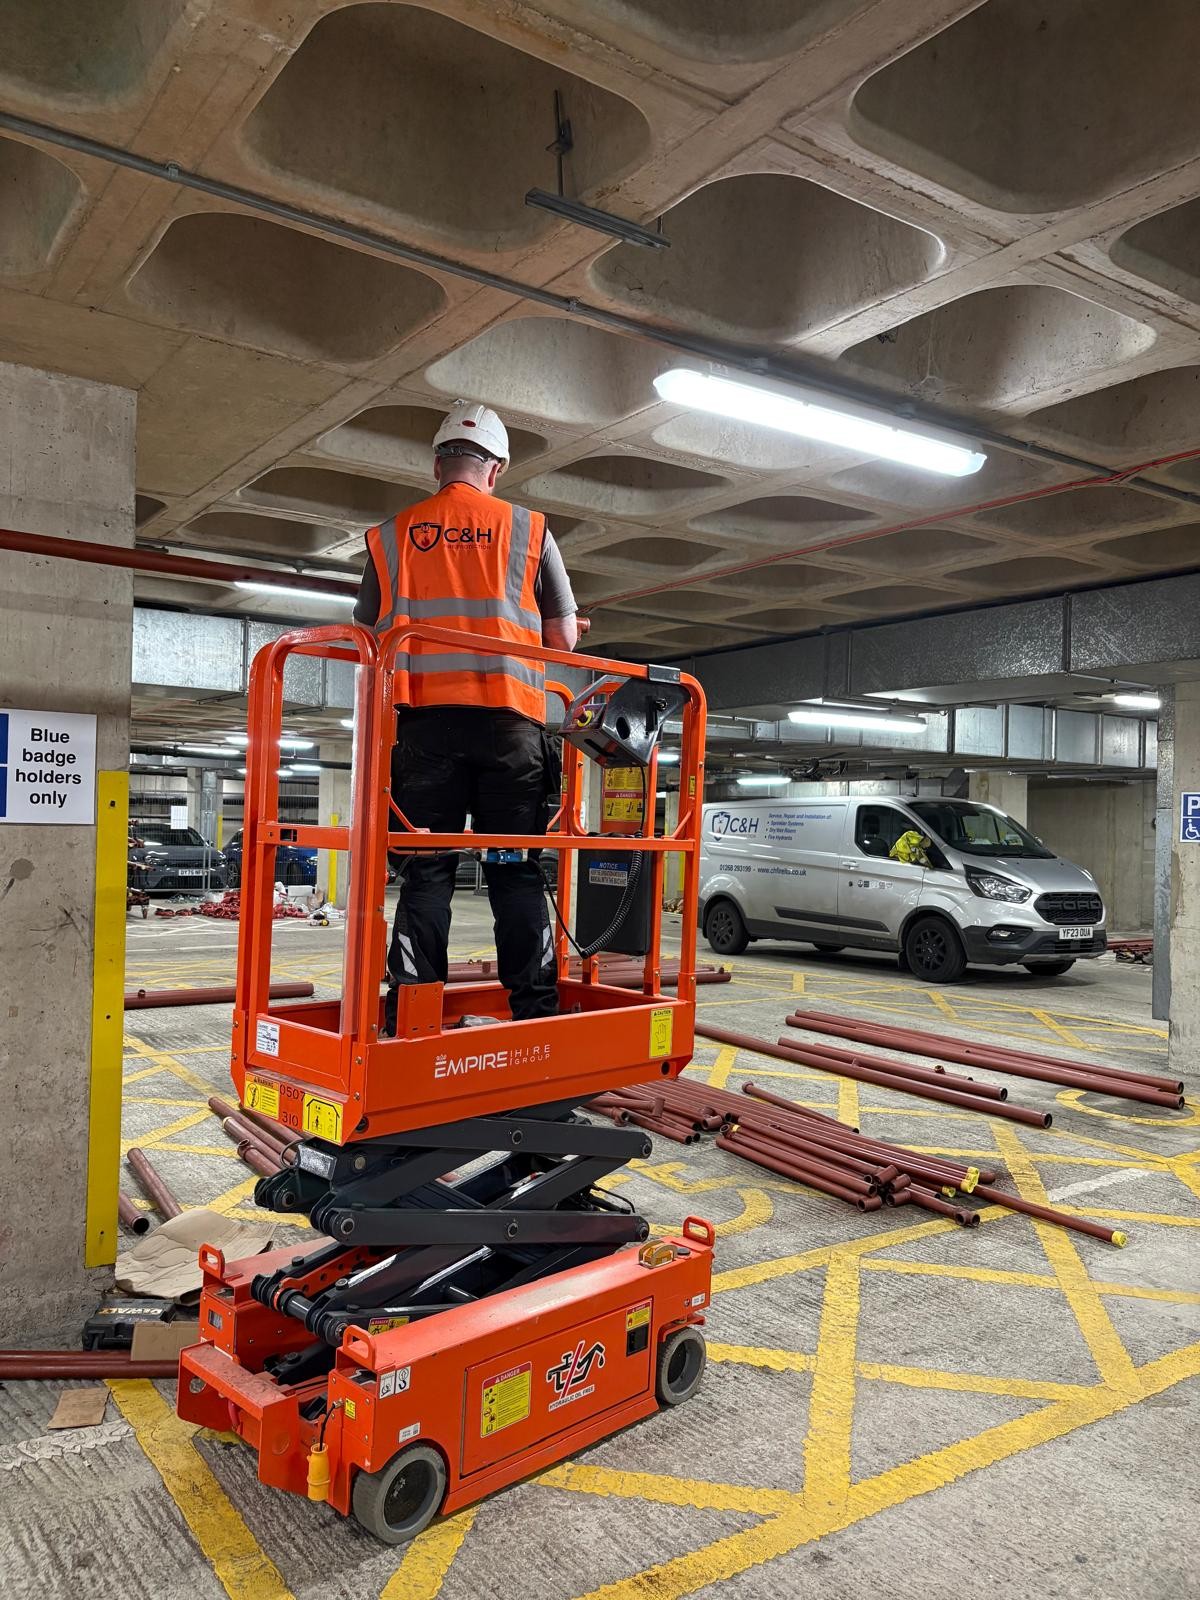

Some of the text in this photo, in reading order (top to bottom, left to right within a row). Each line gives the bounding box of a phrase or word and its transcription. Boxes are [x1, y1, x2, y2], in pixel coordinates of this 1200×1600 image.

[443, 527, 492, 544] C&H
[30, 727, 70, 744] Blue
[22, 748, 77, 767] badge
[15, 768, 82, 785] holders
[29, 790, 67, 808] only
[1187, 796, 1200, 815] P
[729, 818, 760, 834] C&H
[599, 862, 619, 870] NOTICE
[1062, 928, 1079, 938] YF23
[434, 1044, 551, 1078] EMPIRE HIRE
[514, 1053, 551, 1065] GROUP
[500, 1368, 520, 1381] DANGER
